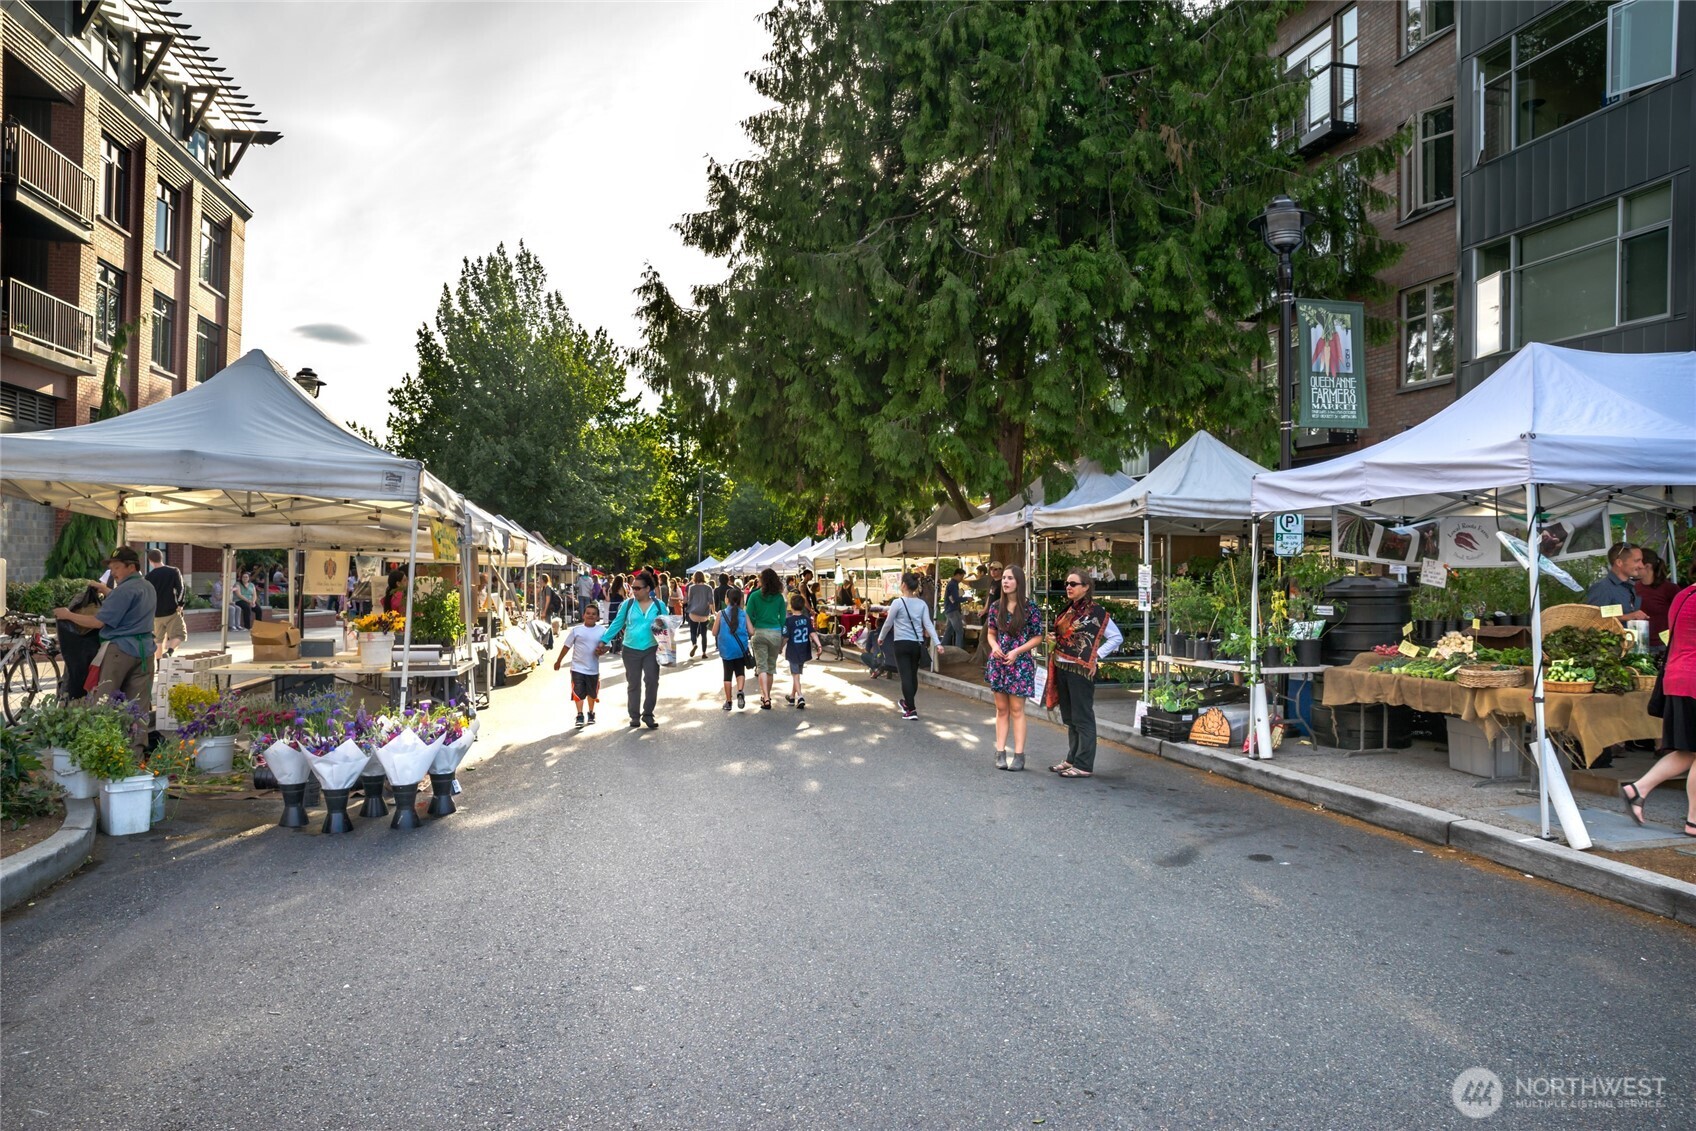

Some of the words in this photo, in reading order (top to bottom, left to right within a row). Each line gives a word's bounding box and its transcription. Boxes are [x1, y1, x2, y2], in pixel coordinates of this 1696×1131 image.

[1310, 376, 1335, 388] QUEEN
[1335, 377, 1357, 389] ANNE
[1311, 387, 1357, 404] FARMERS
[1311, 403, 1358, 411] MARKET
[1285, 515, 1295, 528] P
[1447, 523, 1461, 538] Local
[1461, 522, 1477, 530] Roots
[1477, 525, 1490, 539] Farm
[793, 627, 809, 643] 22
